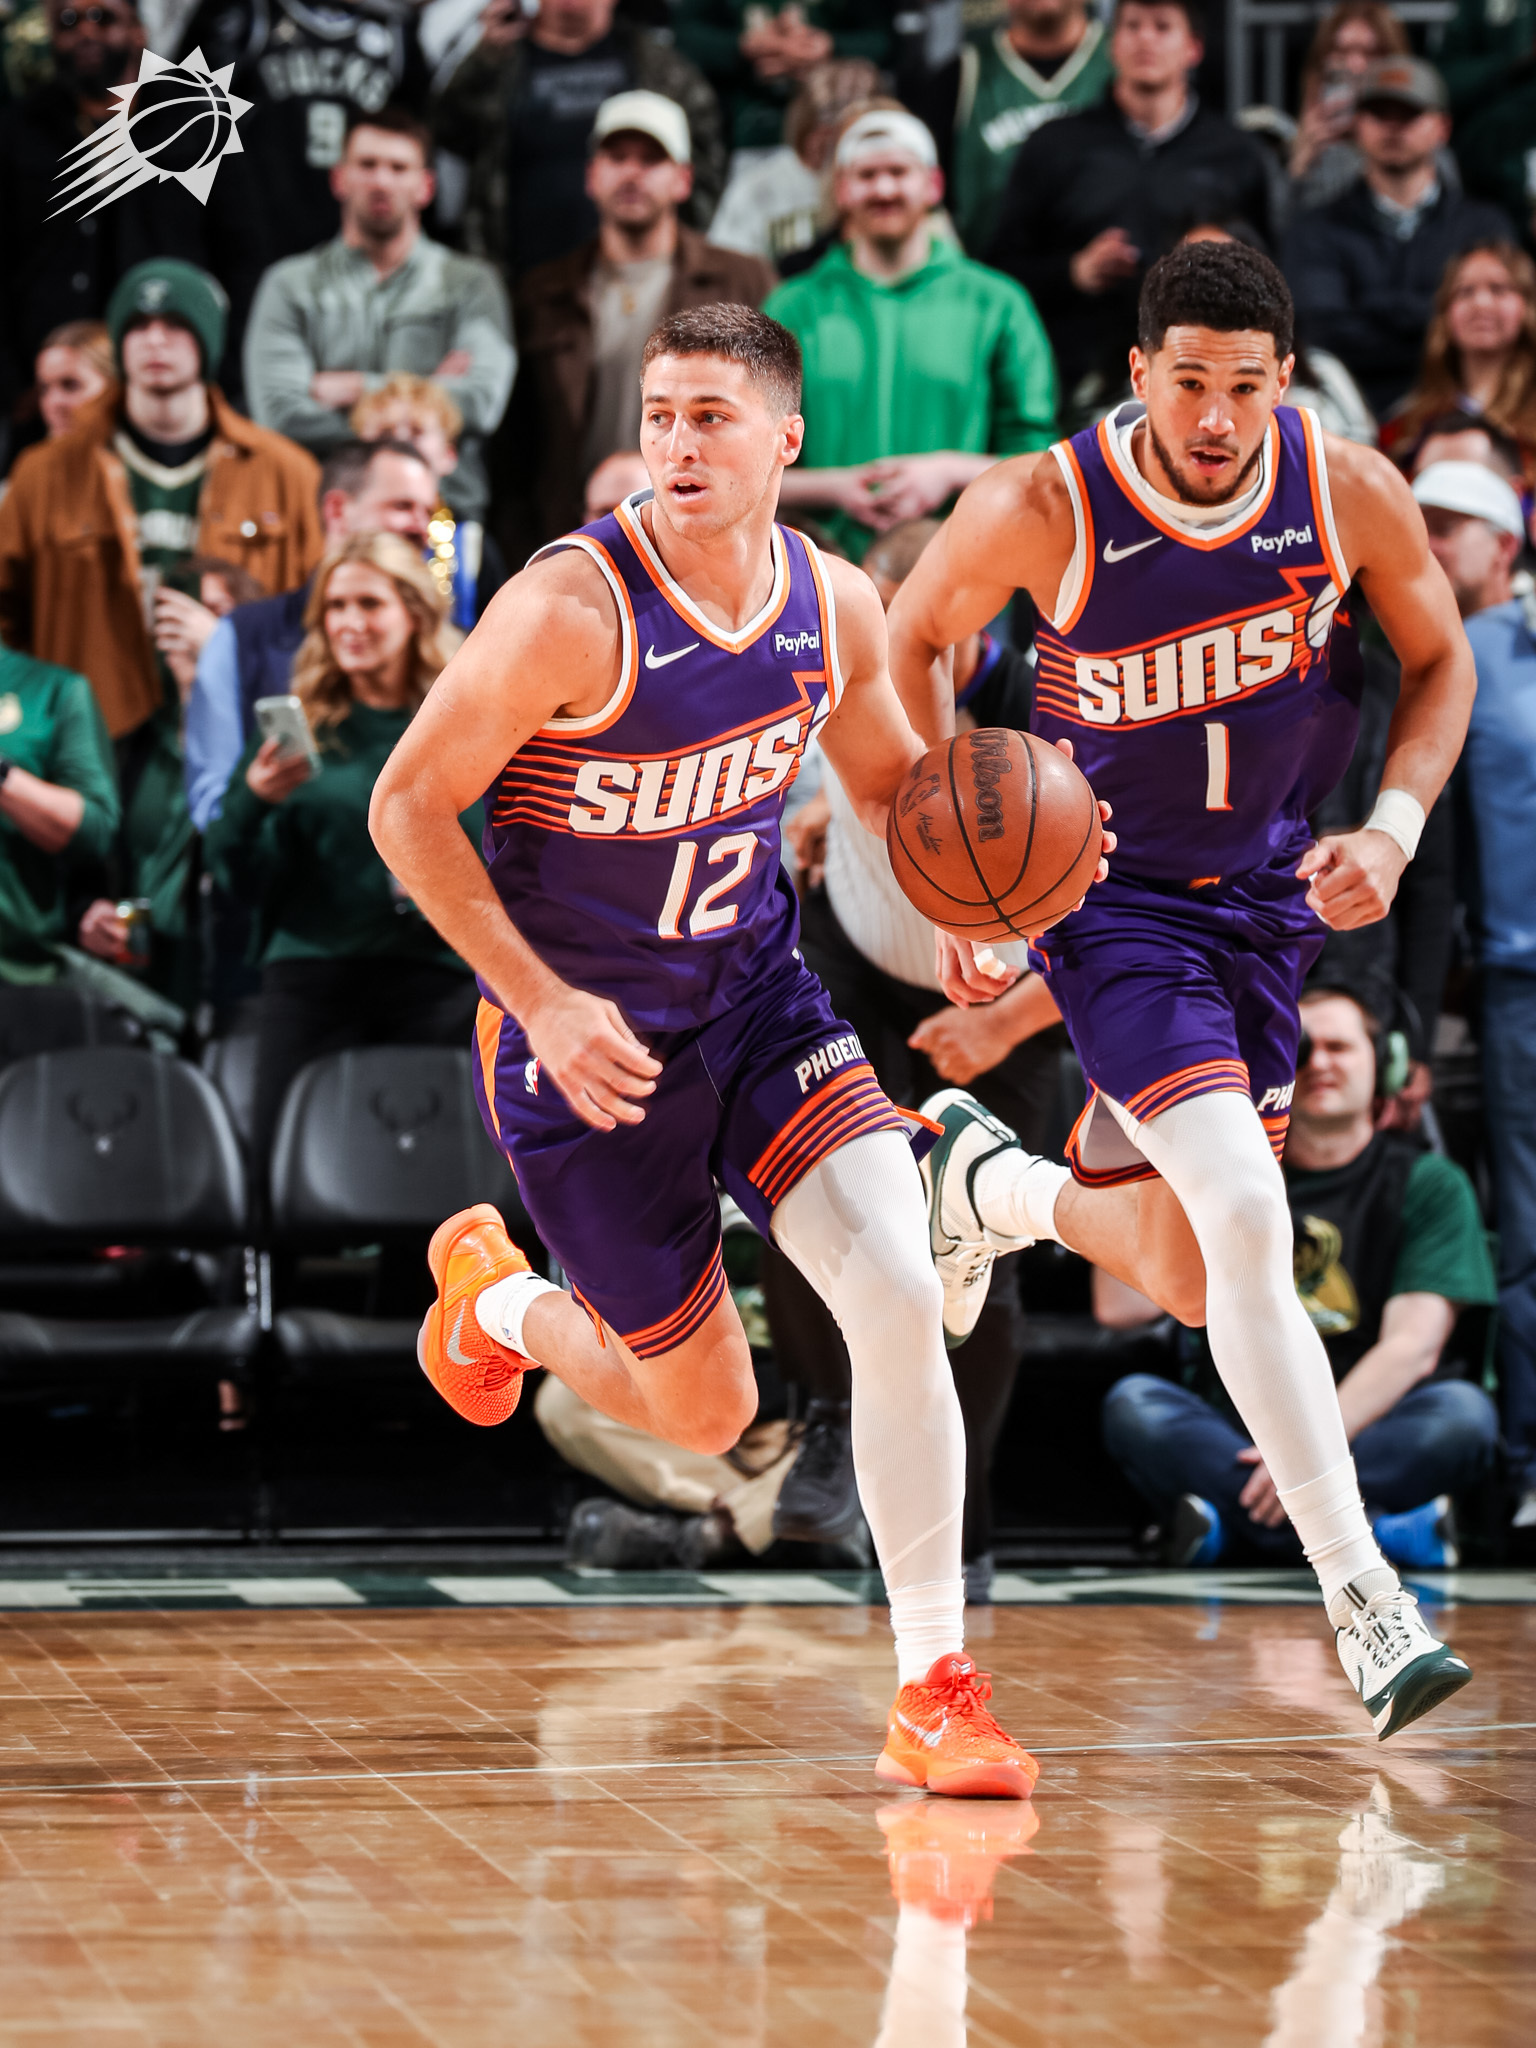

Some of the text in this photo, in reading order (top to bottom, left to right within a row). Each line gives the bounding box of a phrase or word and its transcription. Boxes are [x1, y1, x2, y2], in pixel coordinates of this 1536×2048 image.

[1251, 525, 1313, 554] PayPal
[775, 630, 820, 656] PayPal
[1075, 608, 1294, 724] SUNS
[568, 716, 800, 834] SUNS
[969, 728, 1012, 843] Wilson
[1205, 721, 1233, 811] 1
[658, 832, 759, 939] 12
